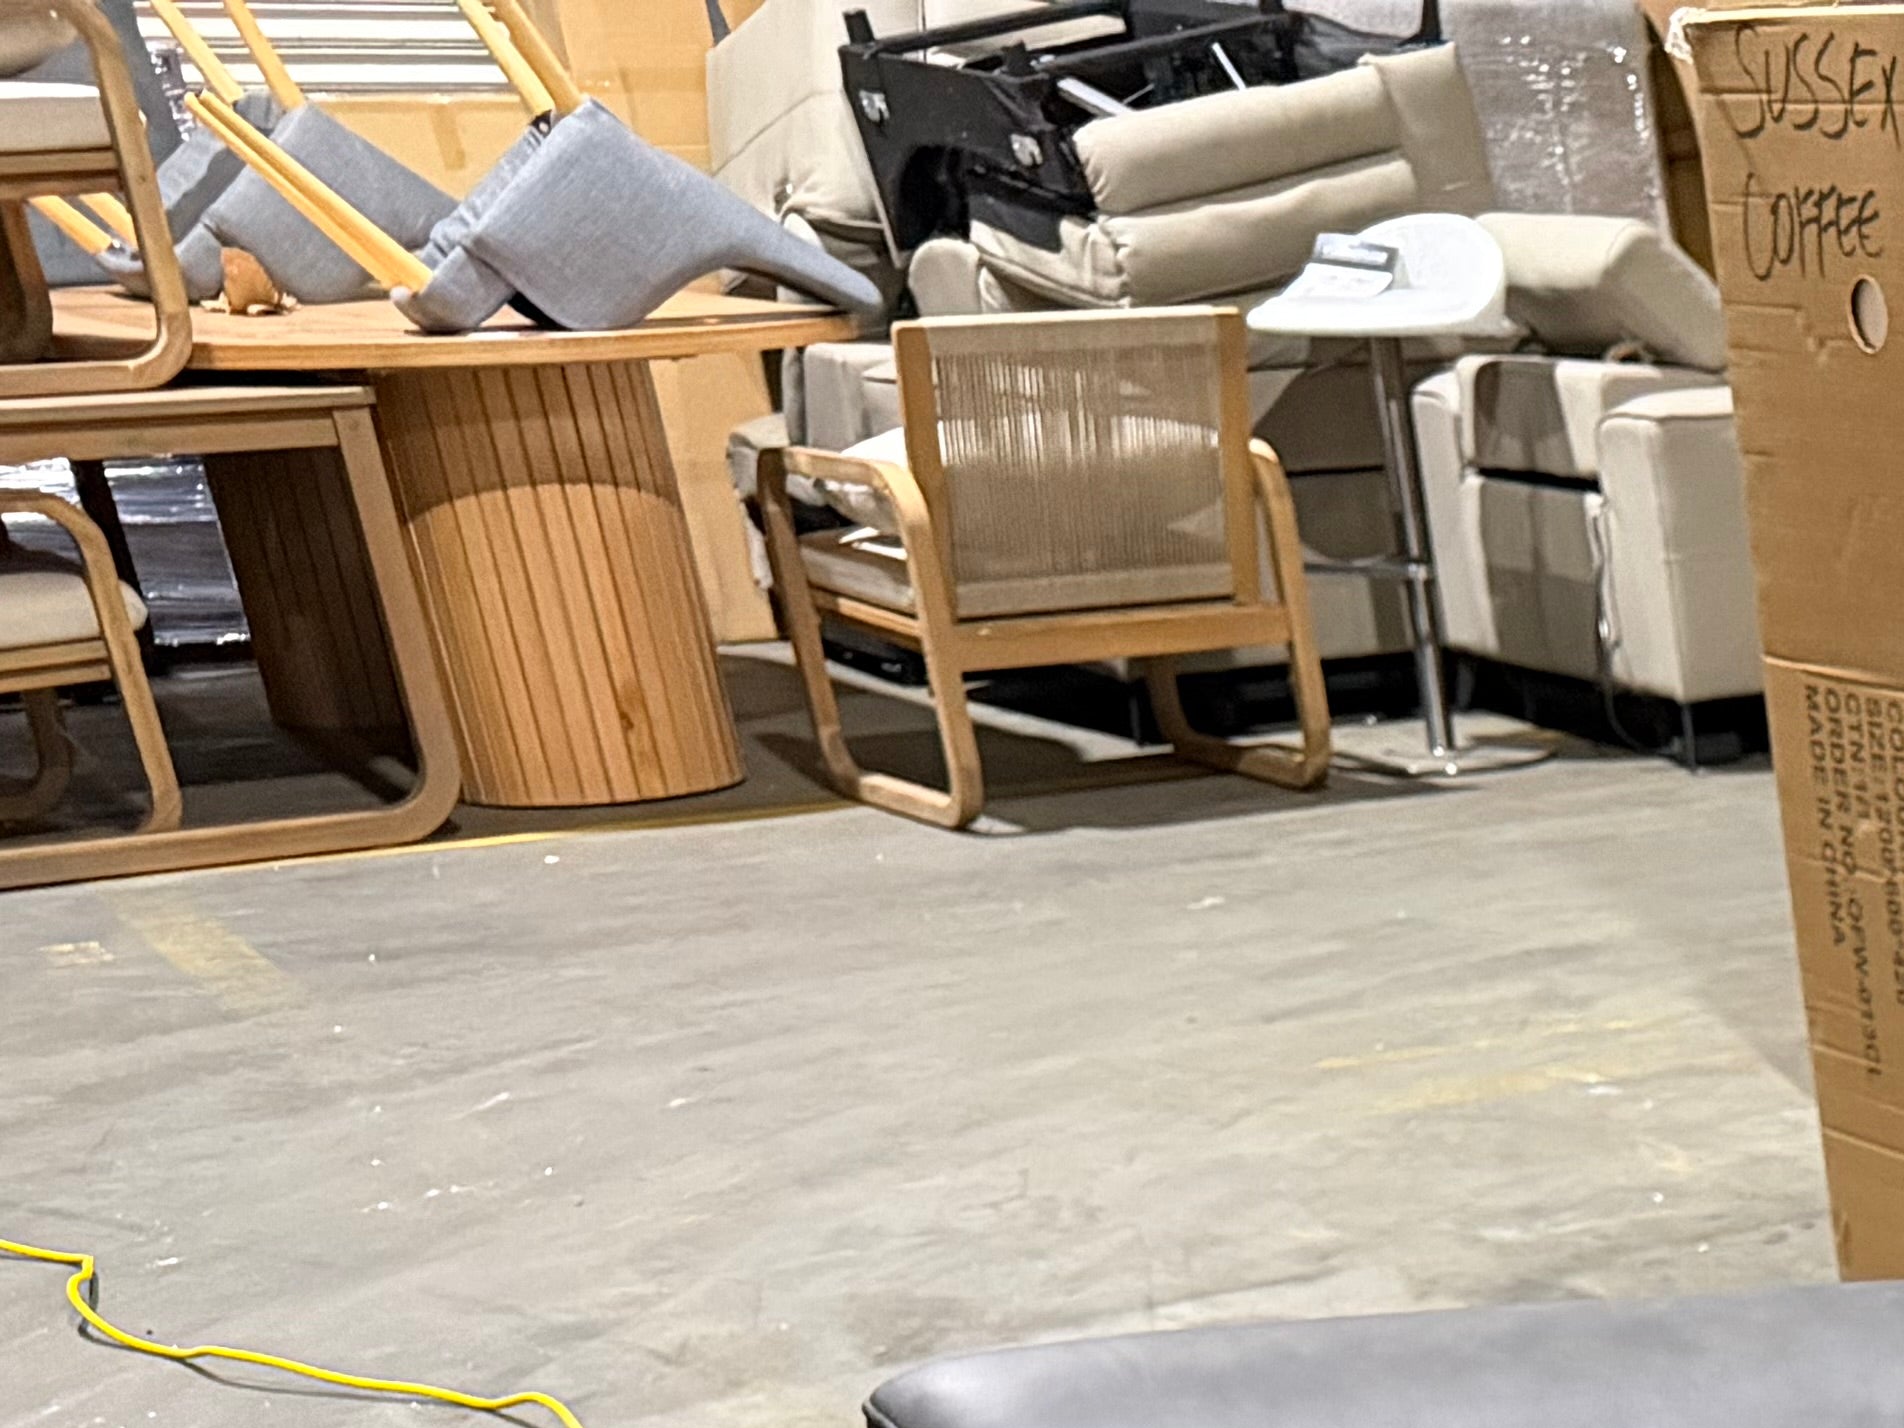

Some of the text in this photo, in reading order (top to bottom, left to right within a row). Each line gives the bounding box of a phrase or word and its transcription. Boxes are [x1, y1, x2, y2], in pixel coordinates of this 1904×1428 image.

[1733, 24, 1900, 150] SUSSEX
[1743, 172, 1882, 281] COFFEE
[1804, 683, 1847, 946] MADE IN CHINA
